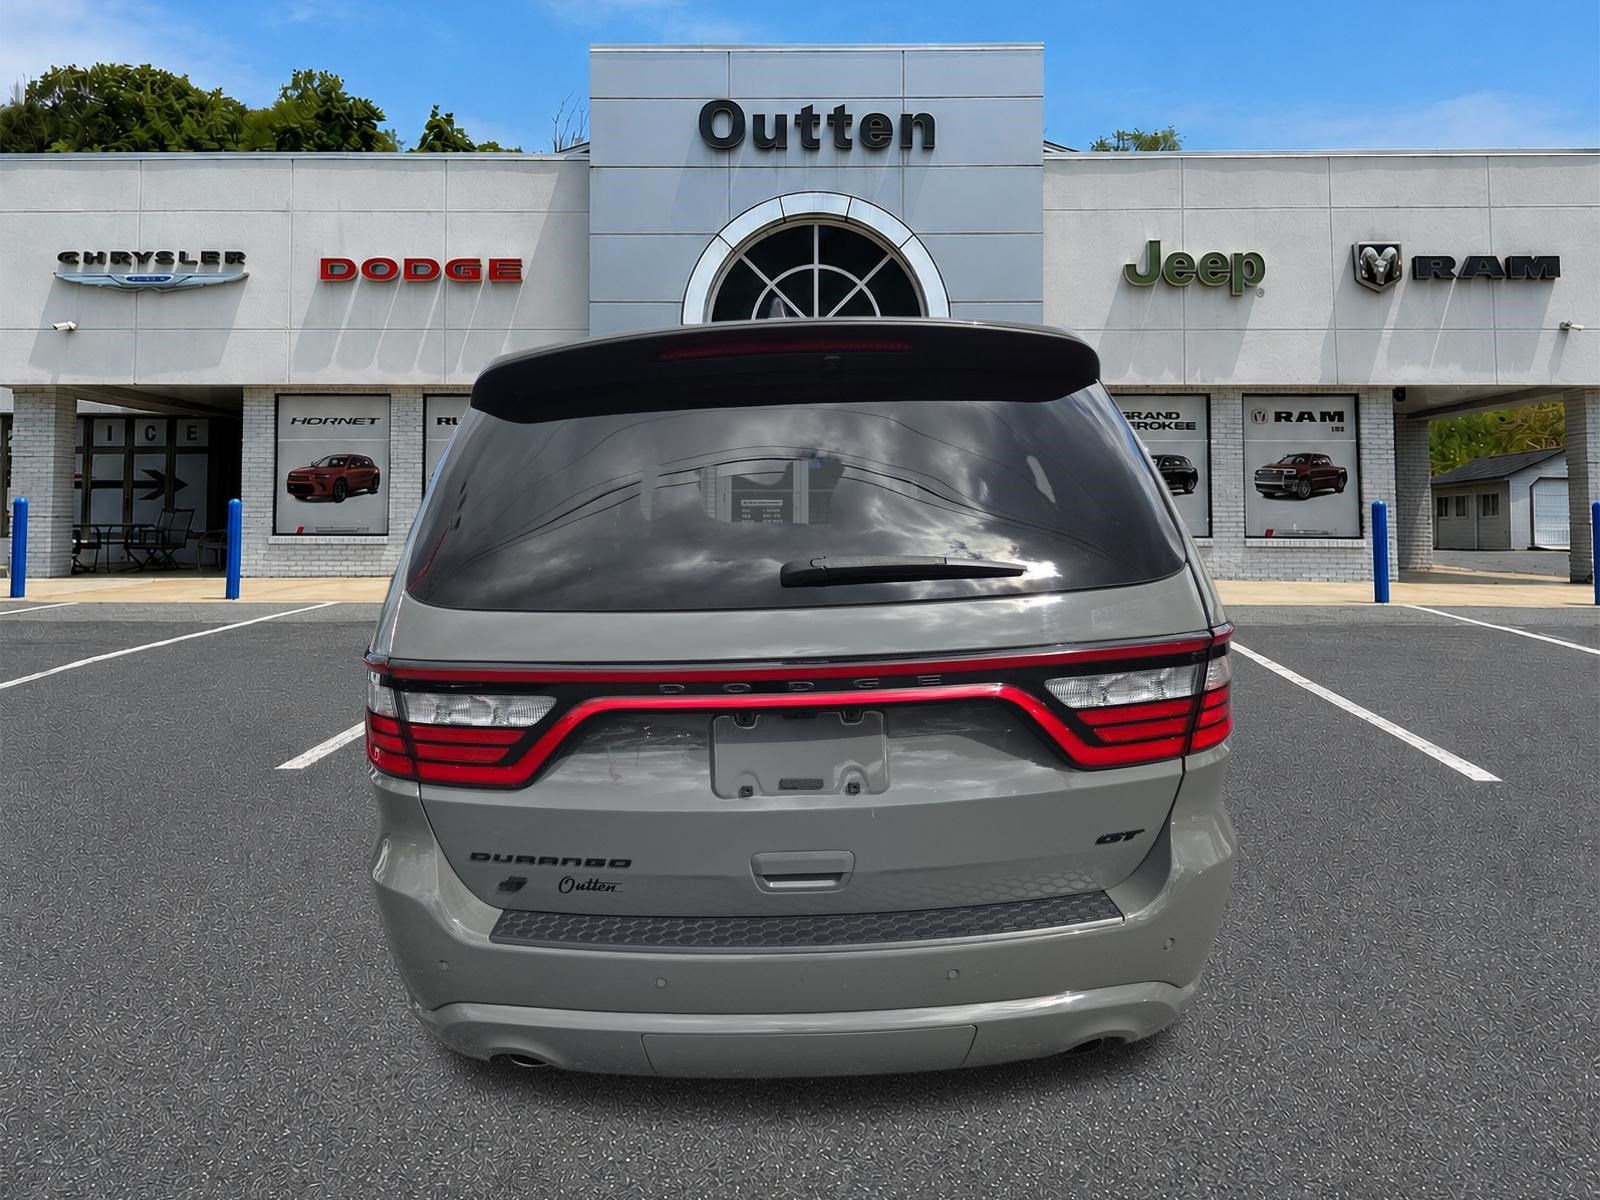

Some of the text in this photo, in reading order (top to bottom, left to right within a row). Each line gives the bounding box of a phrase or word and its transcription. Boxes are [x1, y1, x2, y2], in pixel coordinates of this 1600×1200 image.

[698, 99, 936, 150] Outten
[57, 250, 247, 265] CHRYSLER
[320, 257, 523, 282] DODGE
[1123, 240, 1266, 296] Jeep
[1411, 255, 1561, 280] RAM
[290, 416, 380, 426] HORNET
[1122, 411, 1181, 420] GRAND
[1274, 411, 1345, 423] RAM
[1129, 421, 1197, 431] EROKEE
[658, 674, 942, 694] DODGE
[1095, 829, 1145, 845] GT
[469, 852, 632, 868] DURANGO
[558, 875, 624, 894] Outten
